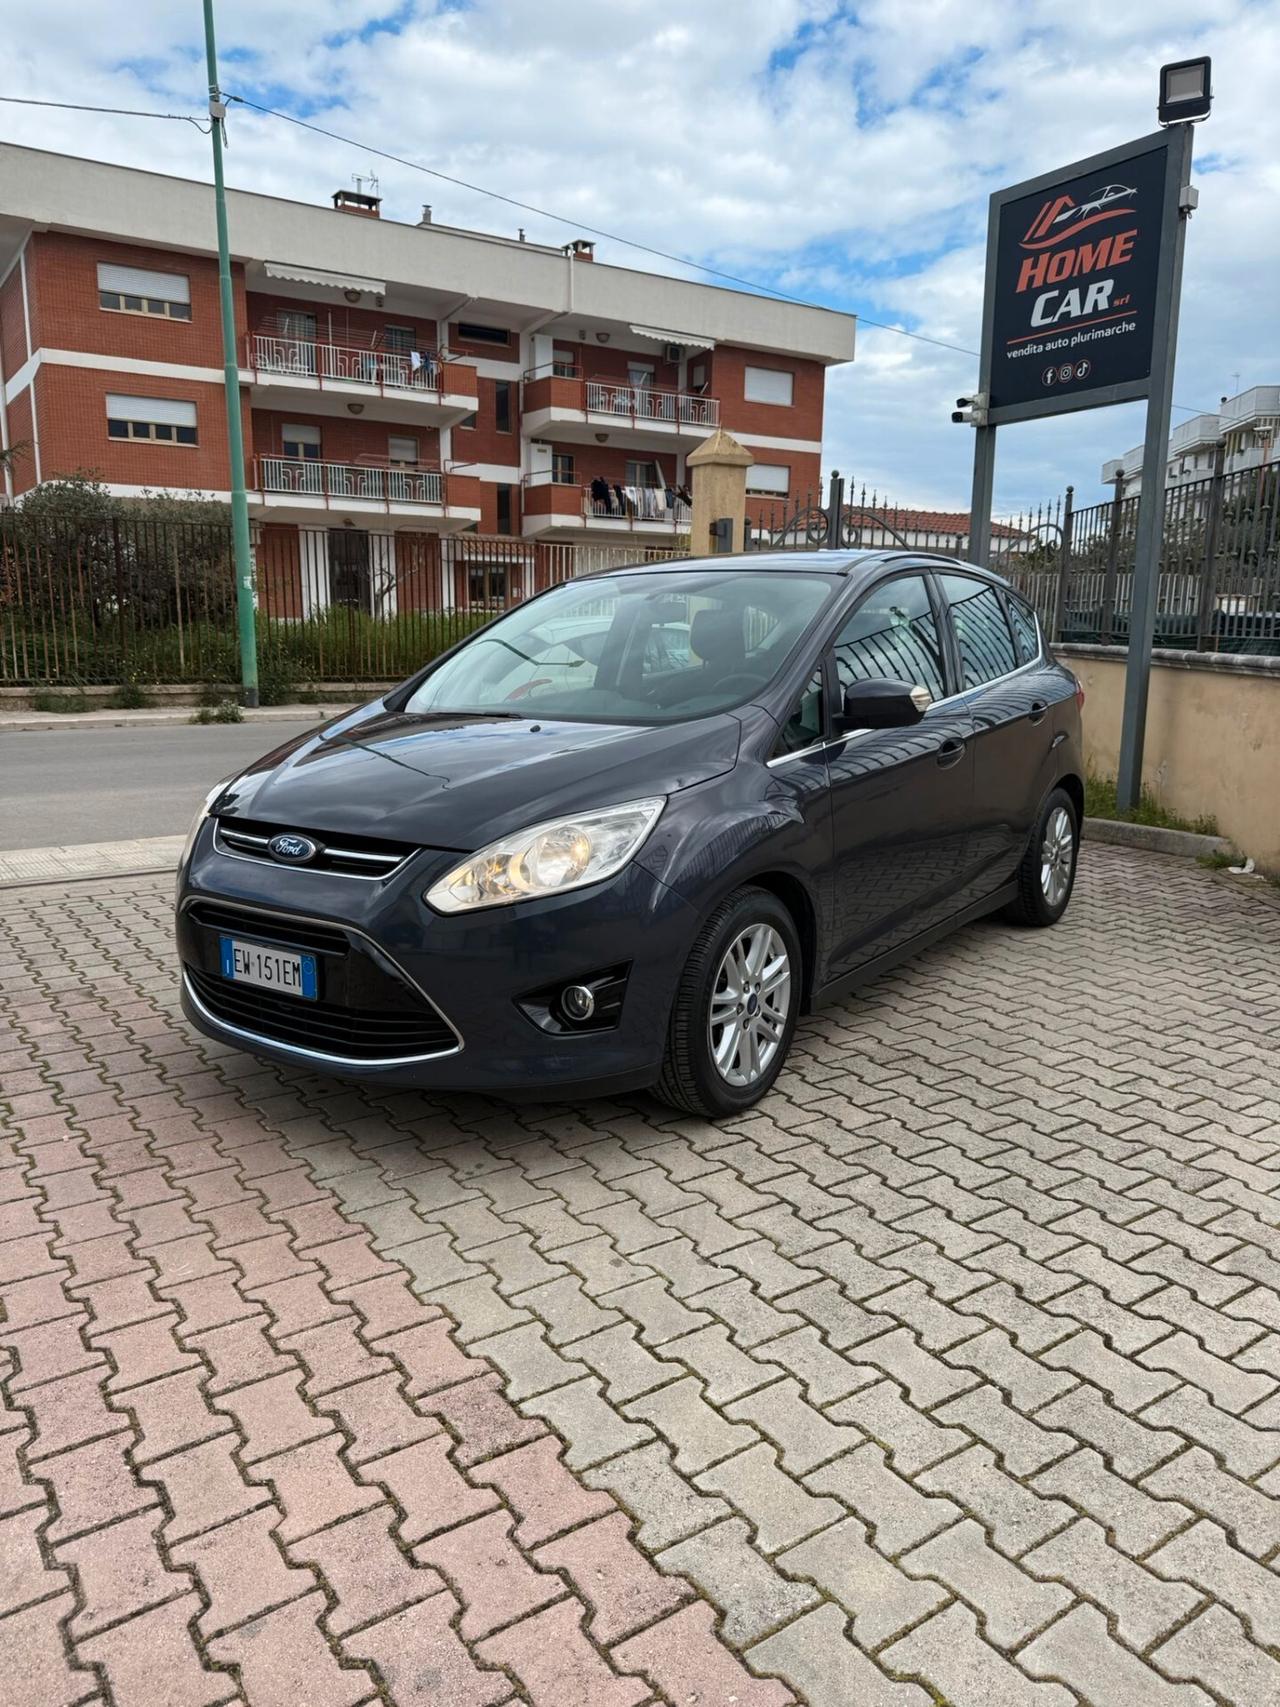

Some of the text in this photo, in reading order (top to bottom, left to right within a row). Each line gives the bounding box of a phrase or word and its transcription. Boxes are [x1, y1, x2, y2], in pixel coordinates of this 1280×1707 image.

[1015, 228, 1138, 293] HOME
[1030, 278, 1130, 328] CAR srl
[1007, 321, 1136, 359] vendita auto plurimarche
[276, 838, 302, 855] Ford
